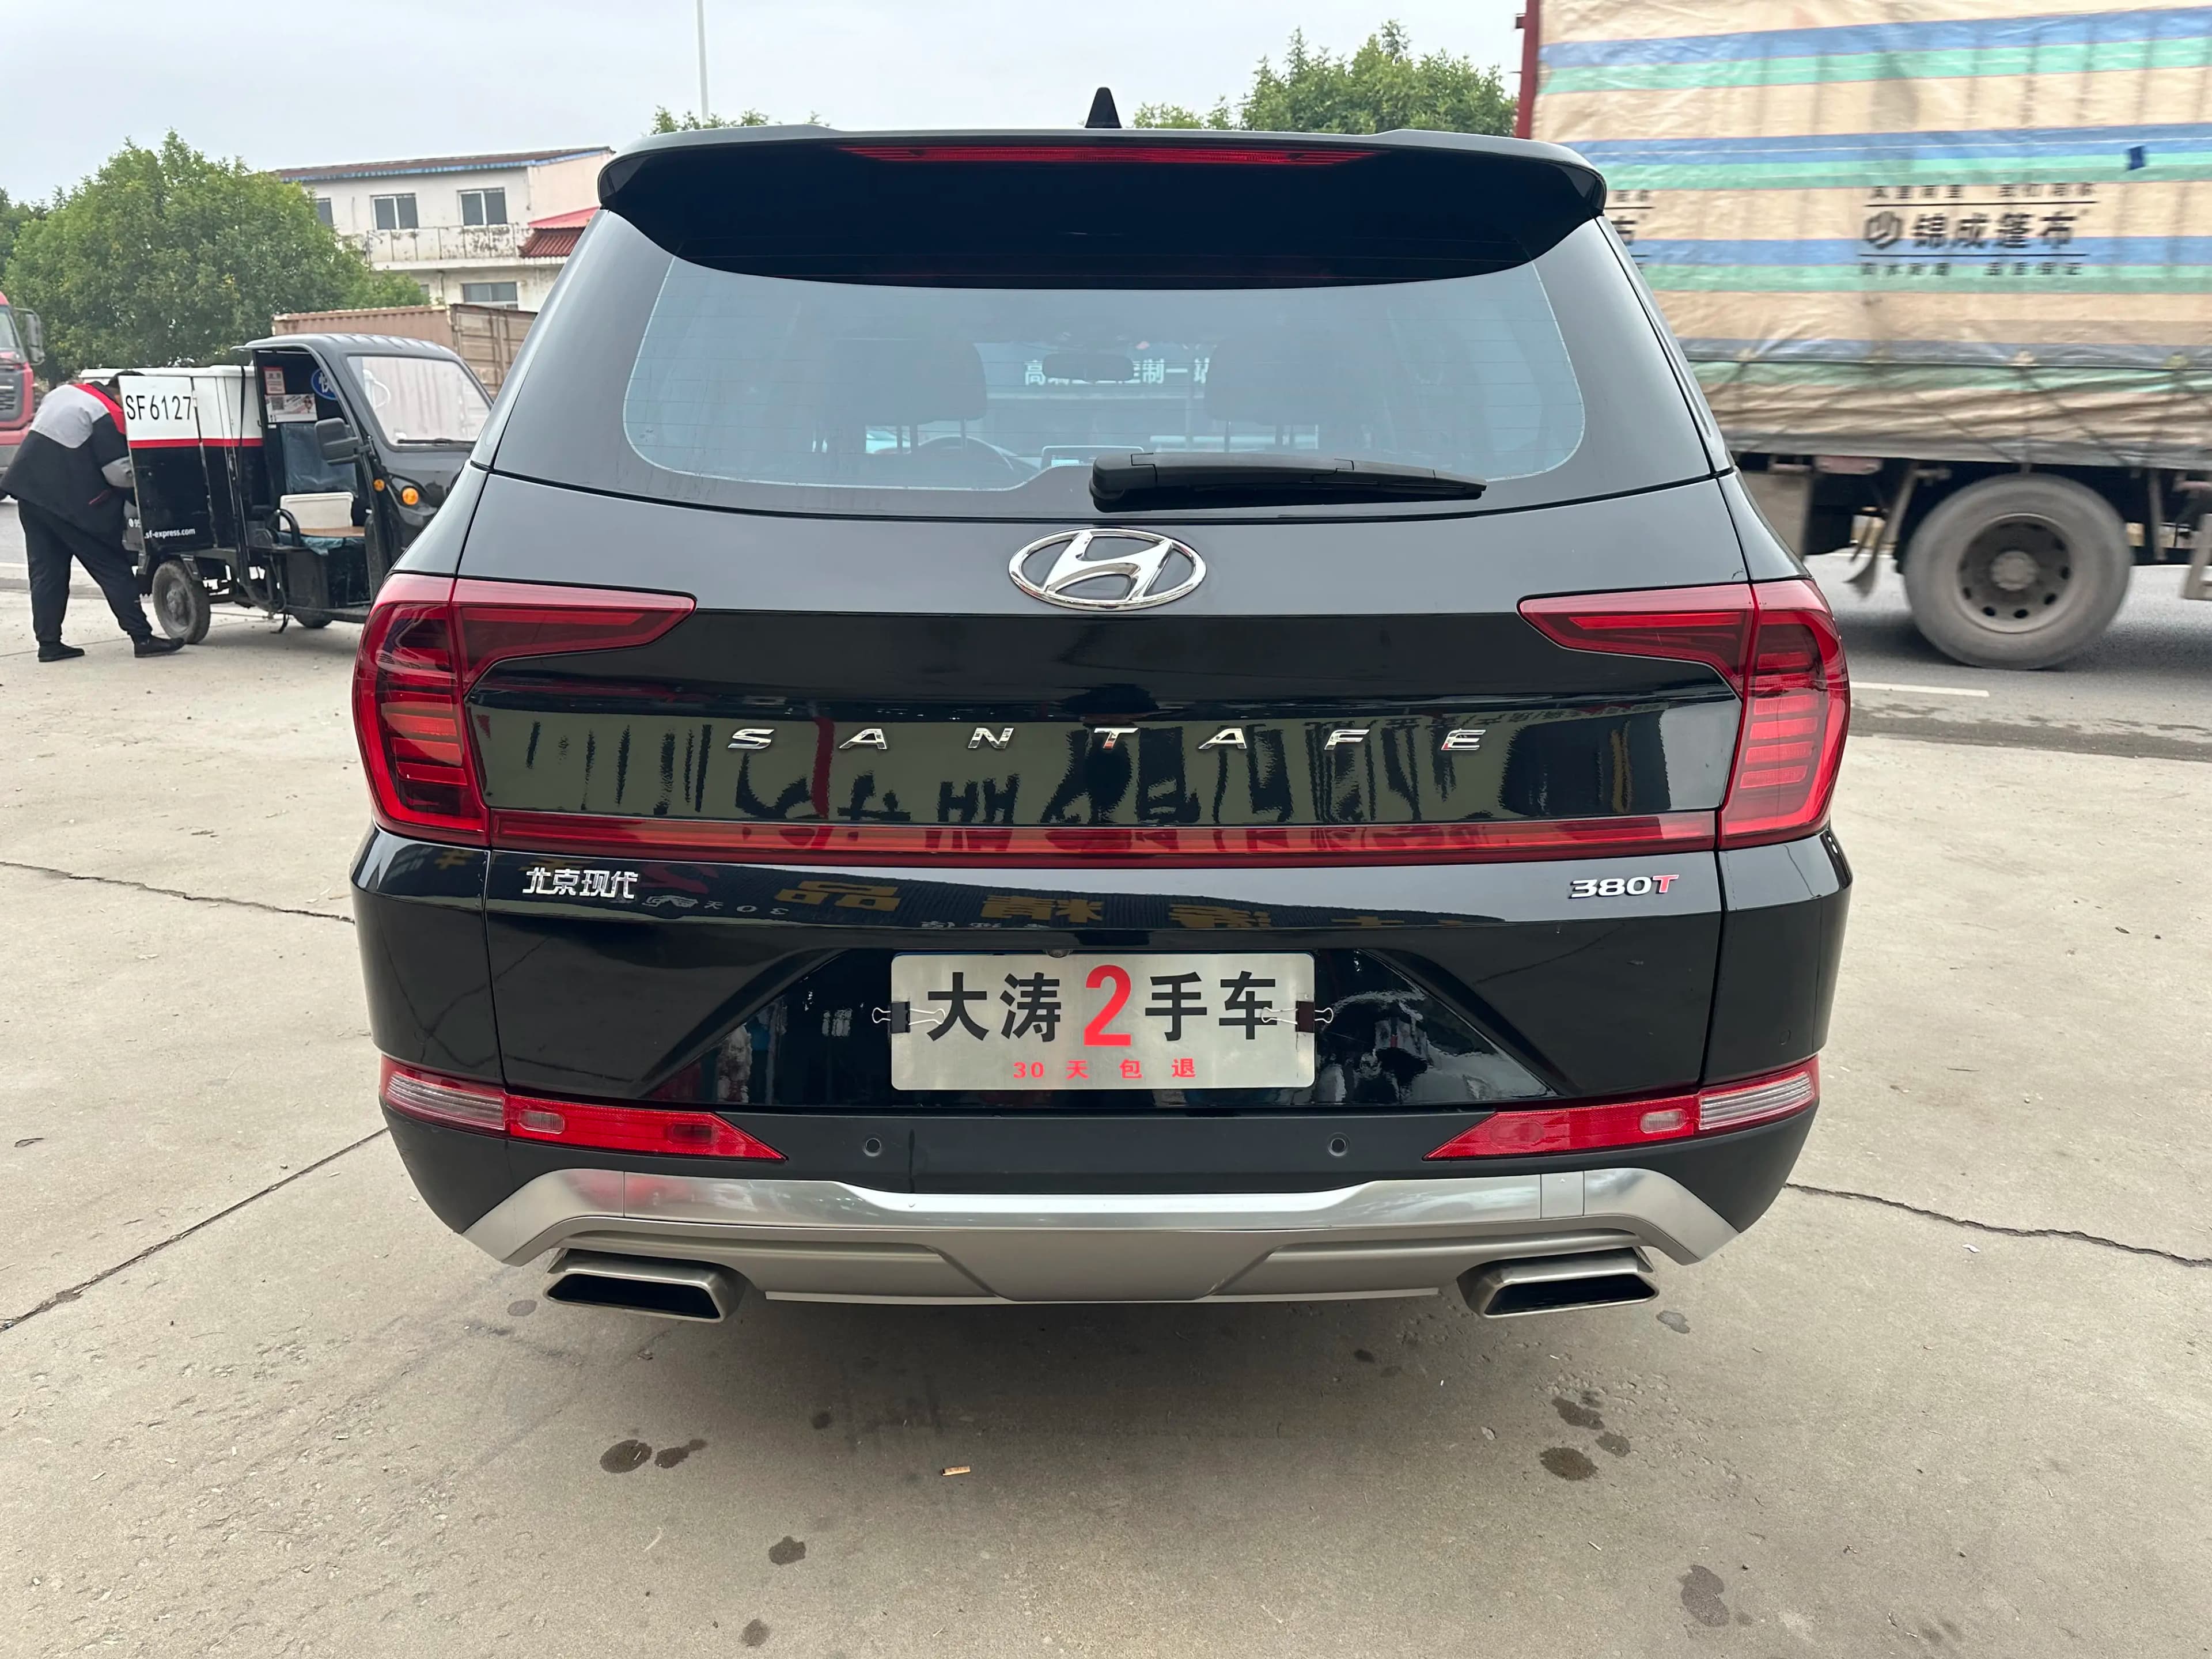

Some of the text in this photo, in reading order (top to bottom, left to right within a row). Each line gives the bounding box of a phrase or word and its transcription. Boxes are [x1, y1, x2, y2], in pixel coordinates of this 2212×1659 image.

[125, 395, 191, 421] SF6127
[522, 867, 639, 899] 北京现代
[1568, 874, 1680, 899] 380T
[926, 965, 1278, 1047] 大涛2手车
